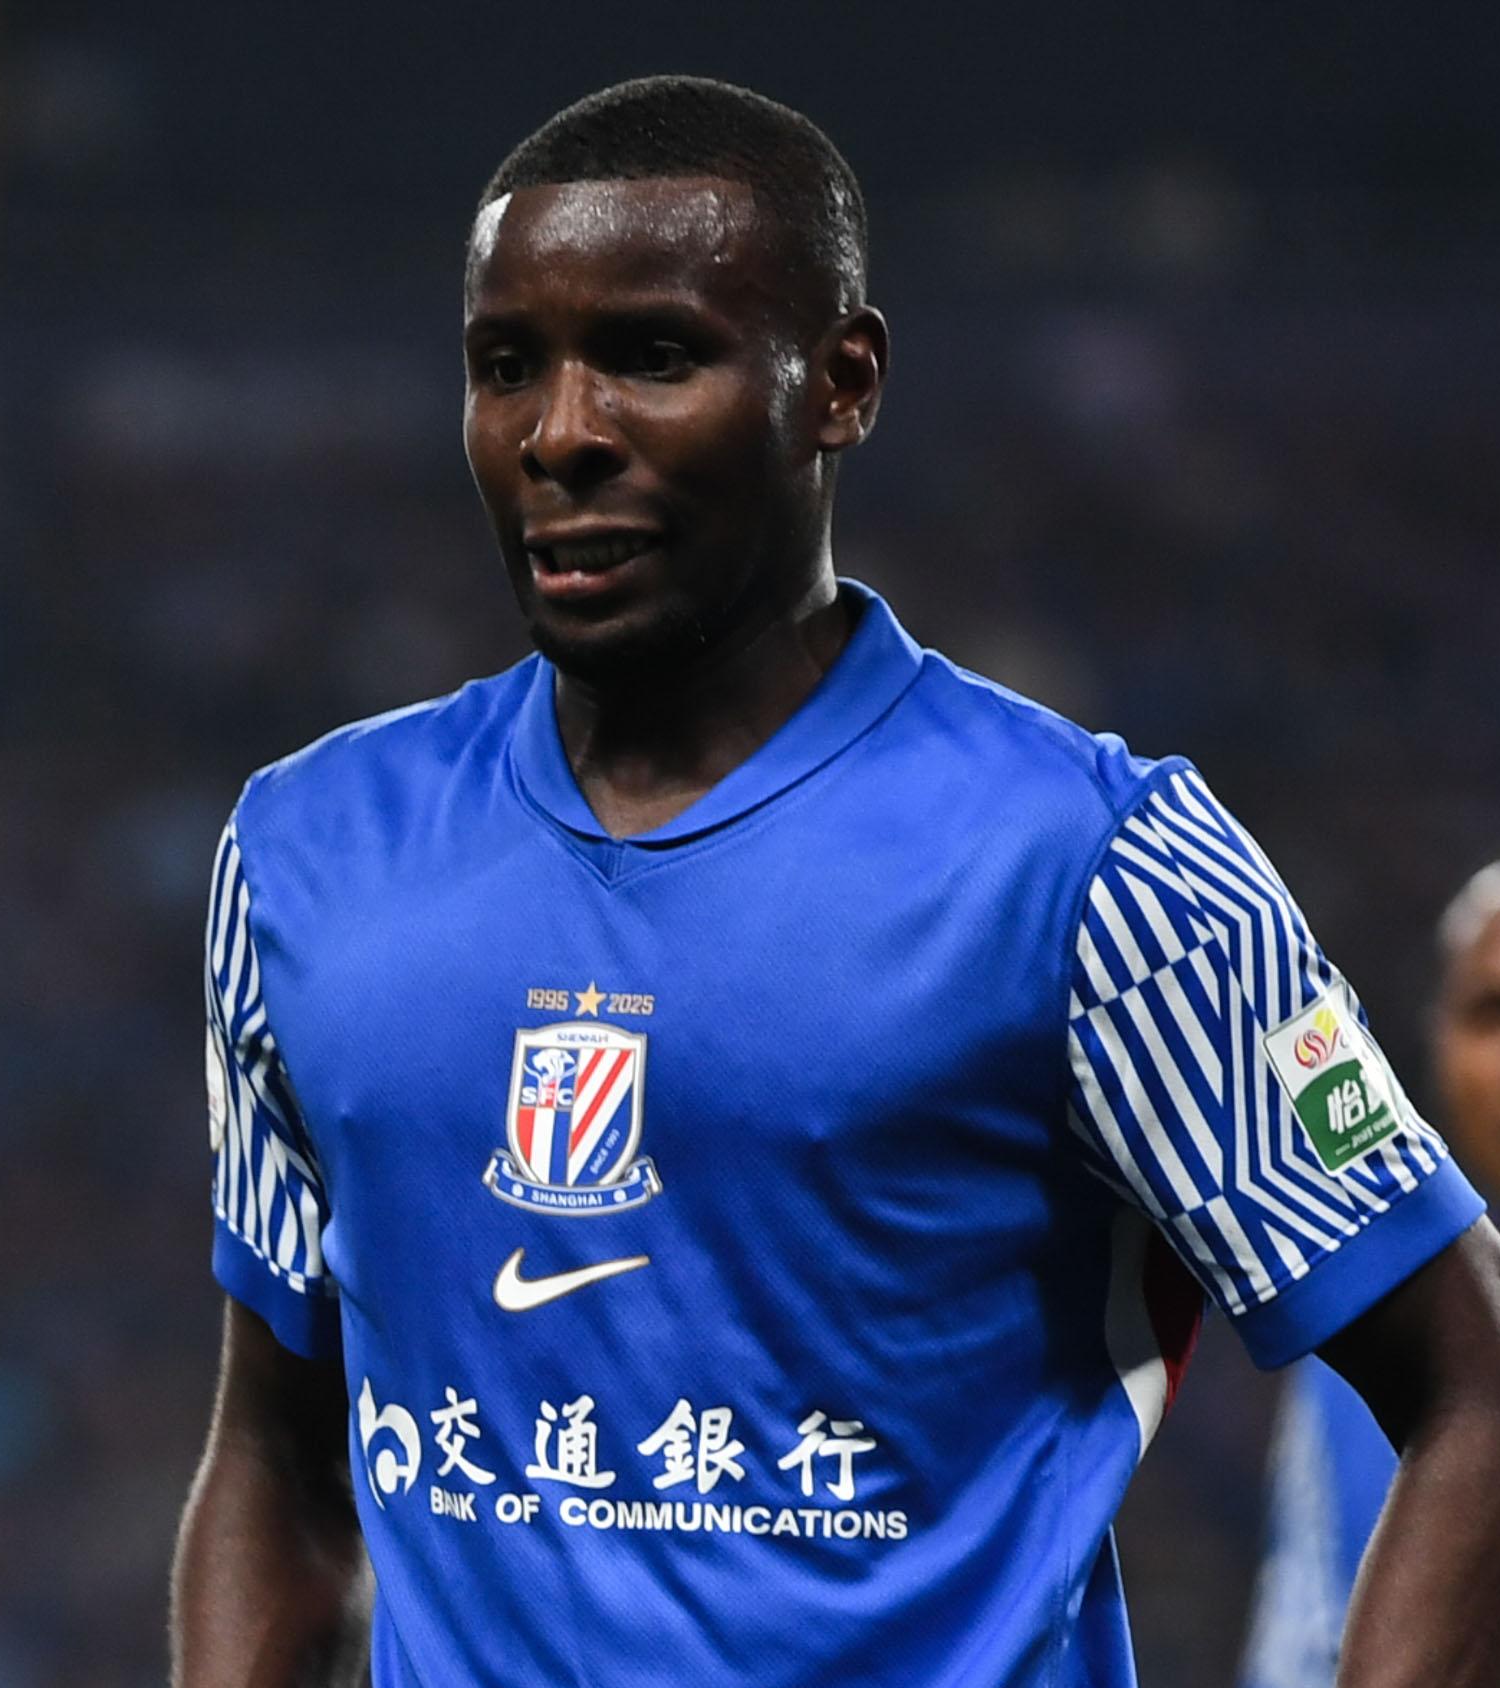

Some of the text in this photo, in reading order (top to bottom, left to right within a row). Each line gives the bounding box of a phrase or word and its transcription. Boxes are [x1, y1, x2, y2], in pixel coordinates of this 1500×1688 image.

[527, 988, 655, 1016] 1995 2025
[521, 1086, 574, 1106] SFC
[531, 1188, 603, 1207] SHANGHAI
[430, 1386, 877, 1501] 交通銀行
[495, 1493, 541, 1525] OF
[559, 1498, 909, 1541] COMMUNICATIONS
